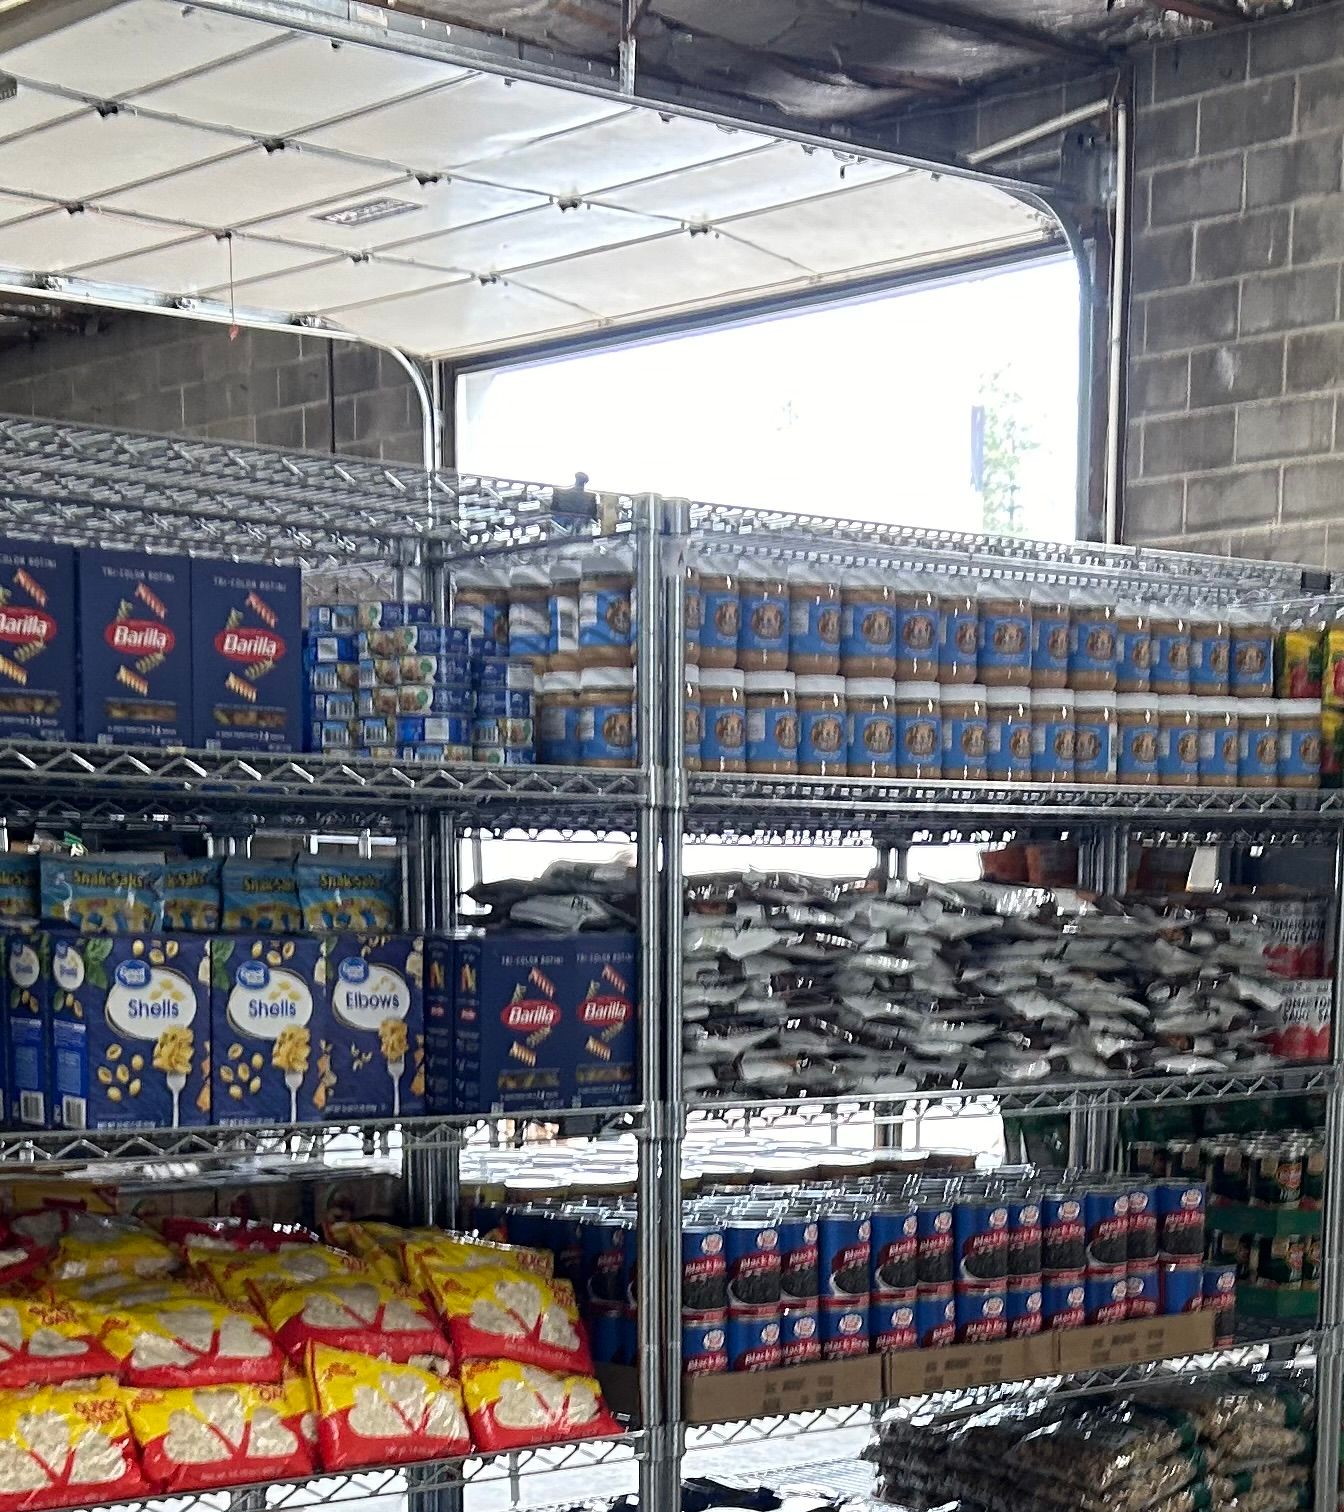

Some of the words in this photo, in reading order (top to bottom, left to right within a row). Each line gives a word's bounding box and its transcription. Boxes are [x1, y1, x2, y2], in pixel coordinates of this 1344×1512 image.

[113, 625, 166, 648] Barilla
[223, 634, 276, 657] Barilla
[127, 999, 180, 1019] Shells
[248, 999, 297, 1019] Shells
[345, 991, 400, 1010] Elbows
[508, 1006, 554, 1025] Barilla
[584, 1002, 627, 1021] Barilla
